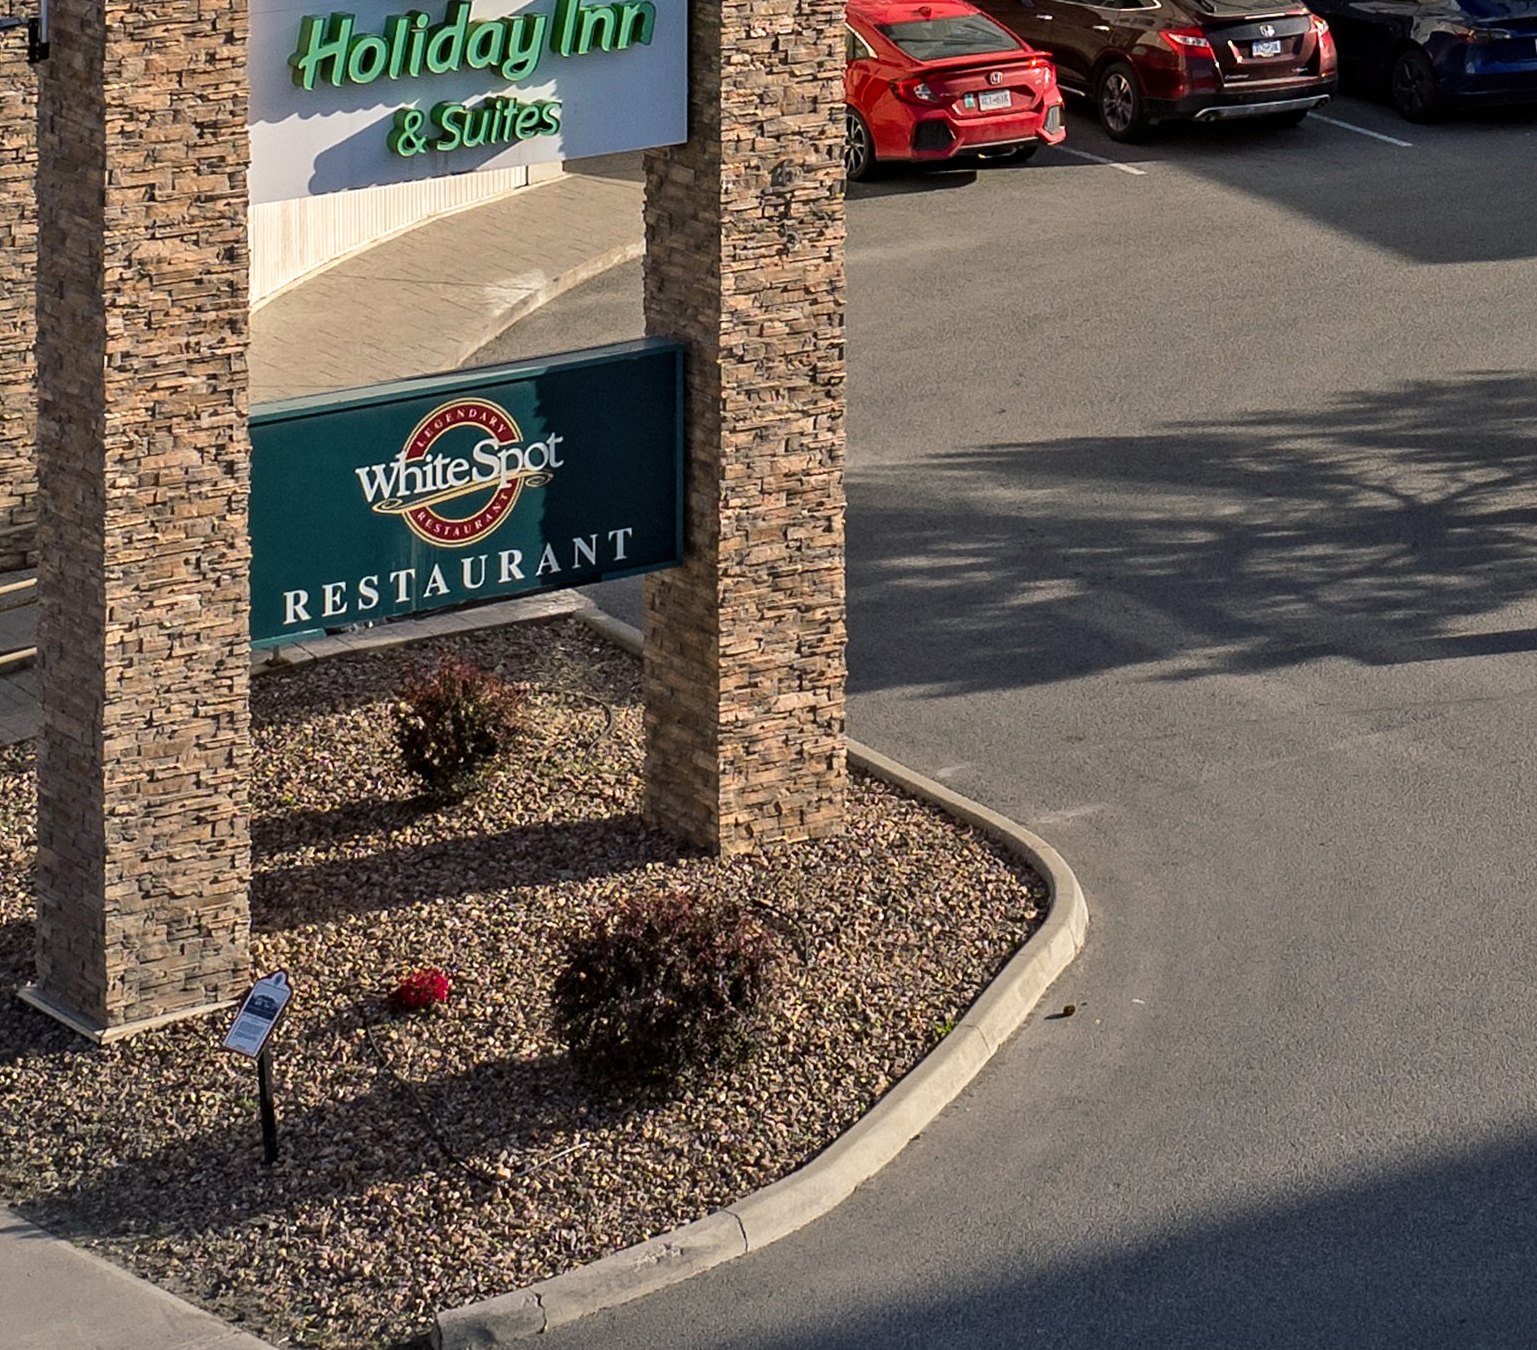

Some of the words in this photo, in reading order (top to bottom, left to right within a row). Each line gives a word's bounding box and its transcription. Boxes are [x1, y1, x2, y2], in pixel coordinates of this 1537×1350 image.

[294, 1, 547, 91] Holiday
[390, 107, 429, 157] &
[433, 97, 561, 153] Suites
[416, 409, 508, 448] LEGENDARY
[416, 492, 509, 537] RESTAURANT
[281, 527, 634, 626] RESTAURANT
